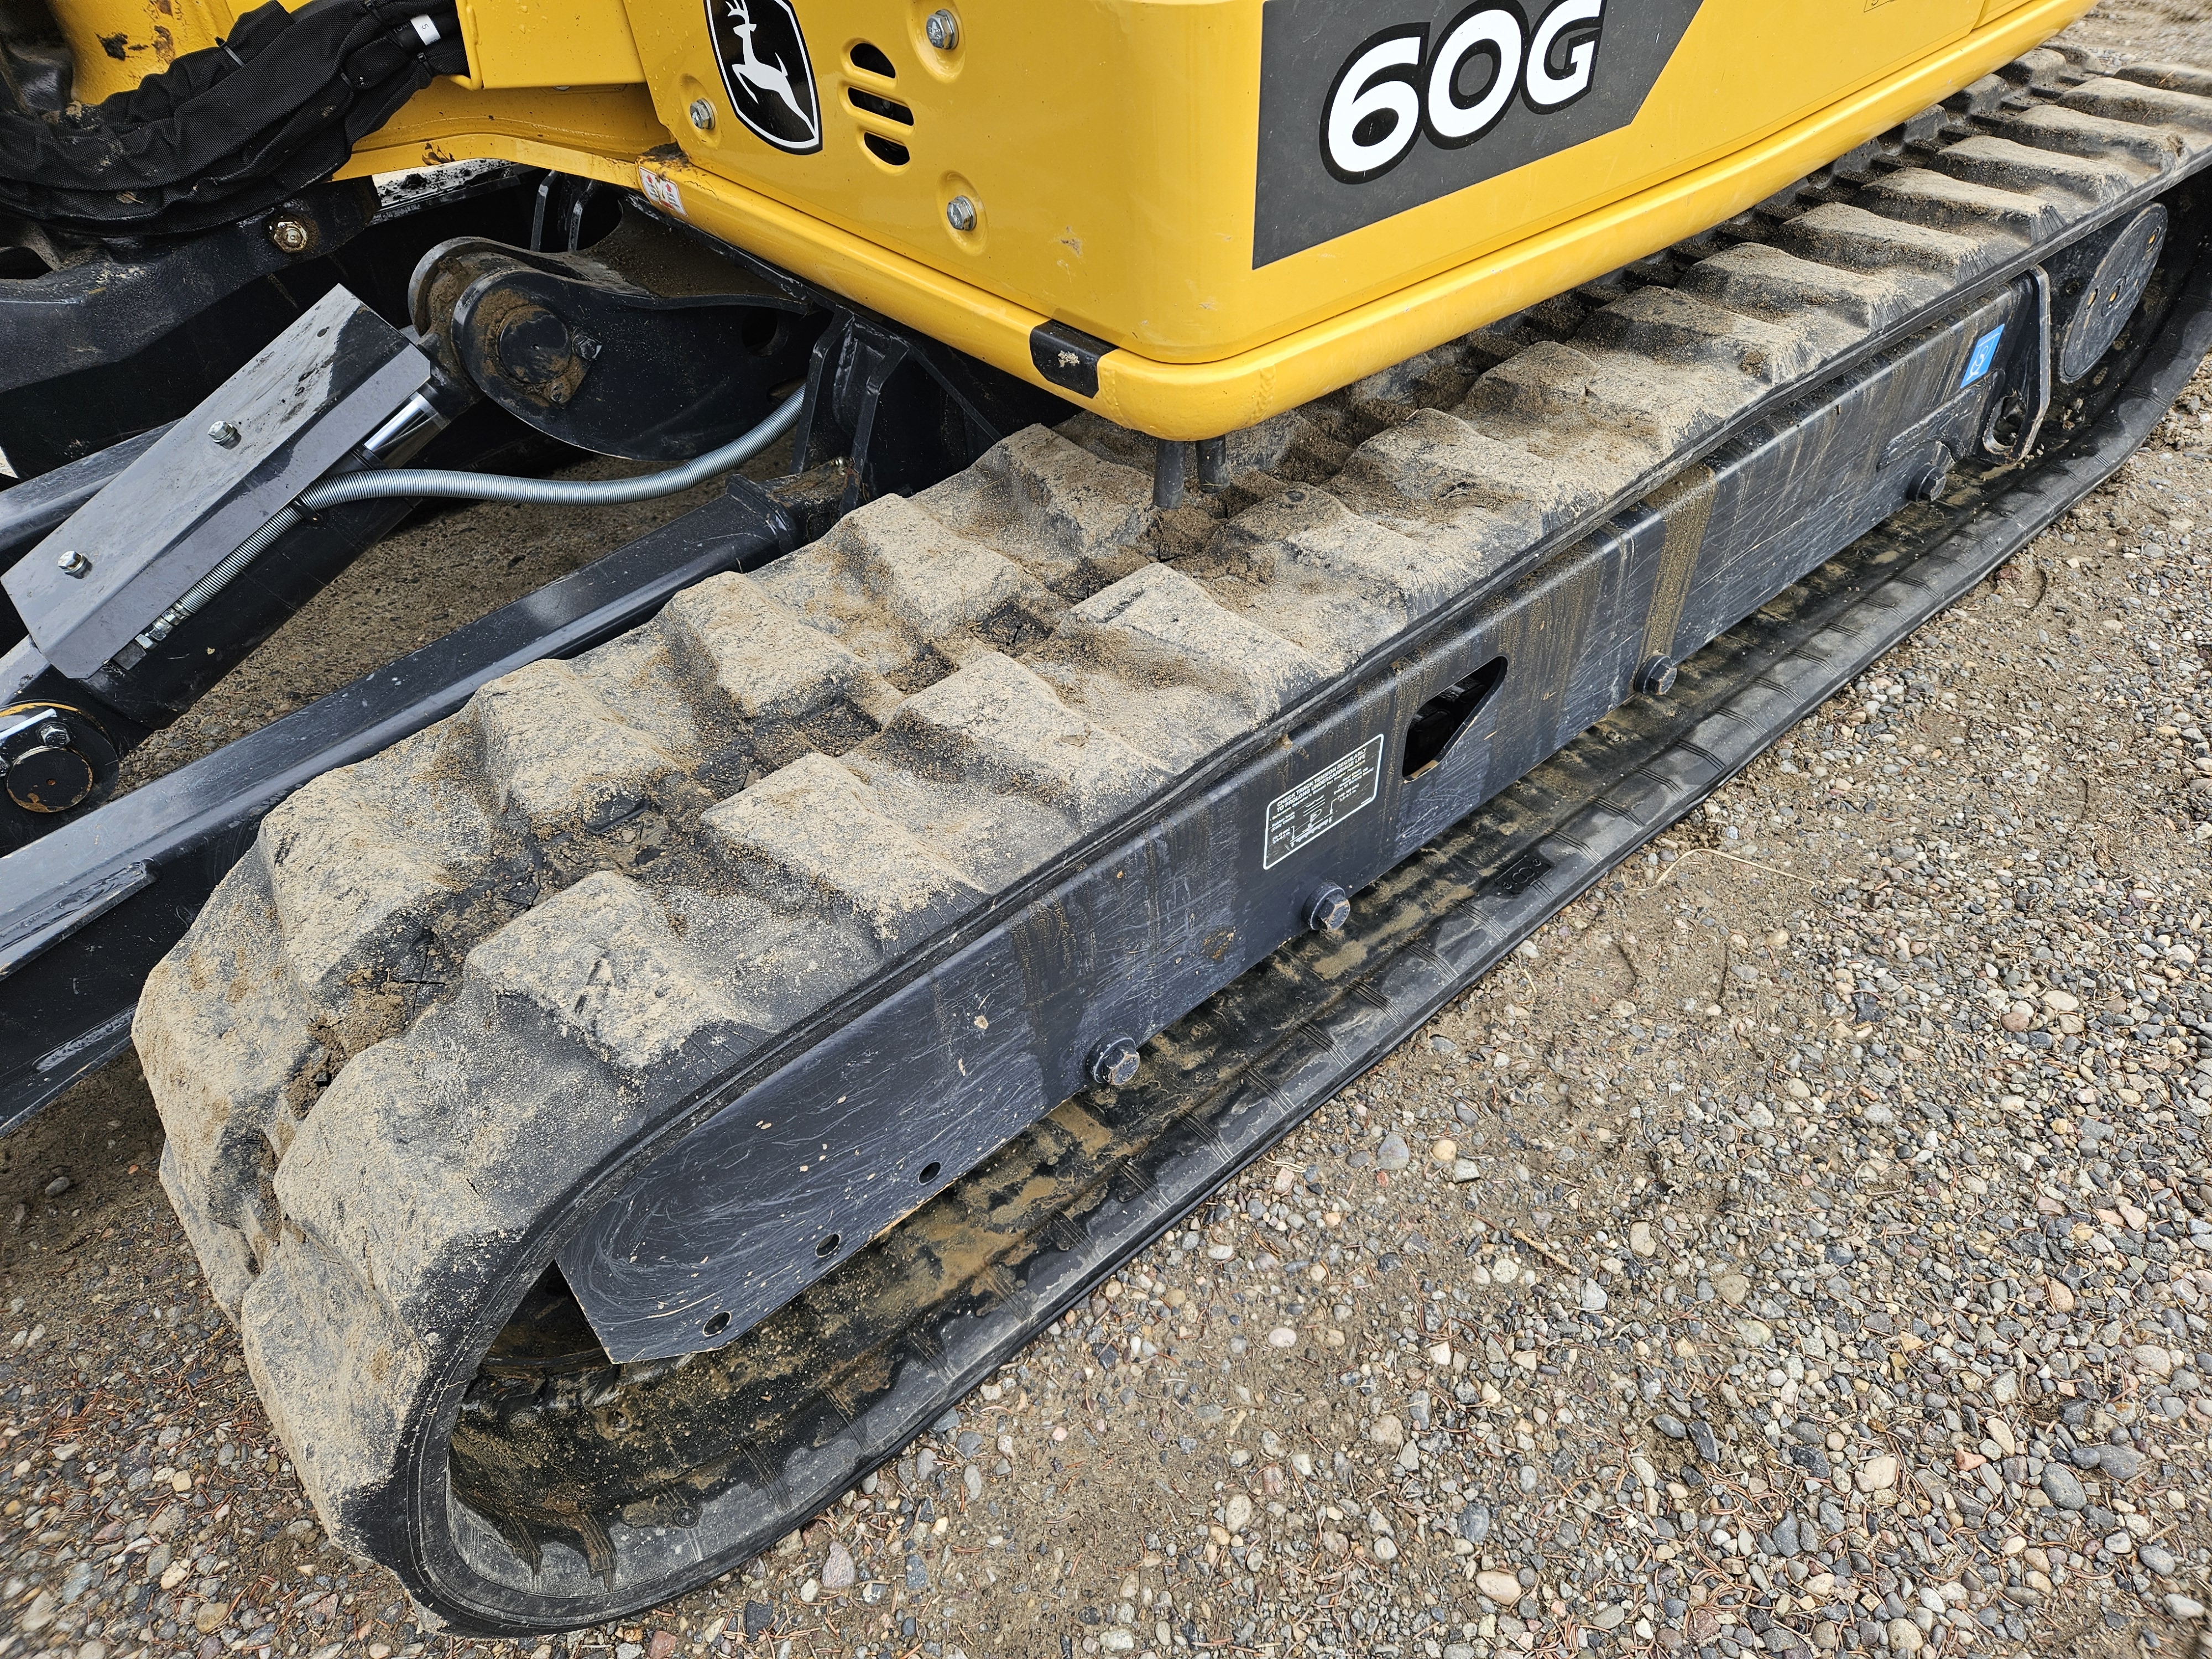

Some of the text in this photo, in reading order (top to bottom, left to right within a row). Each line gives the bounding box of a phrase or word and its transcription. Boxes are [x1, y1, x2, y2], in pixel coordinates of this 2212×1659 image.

[1328, 0, 1603, 172] 60G
[1277, 748, 1366, 806] CHECK TRACK TENSION REGULARLY
[1285, 789, 1310, 807] PROLONG
[1311, 761, 1354, 791] UNDERCARRIAGE
[1355, 753, 1365, 763] LIFE
